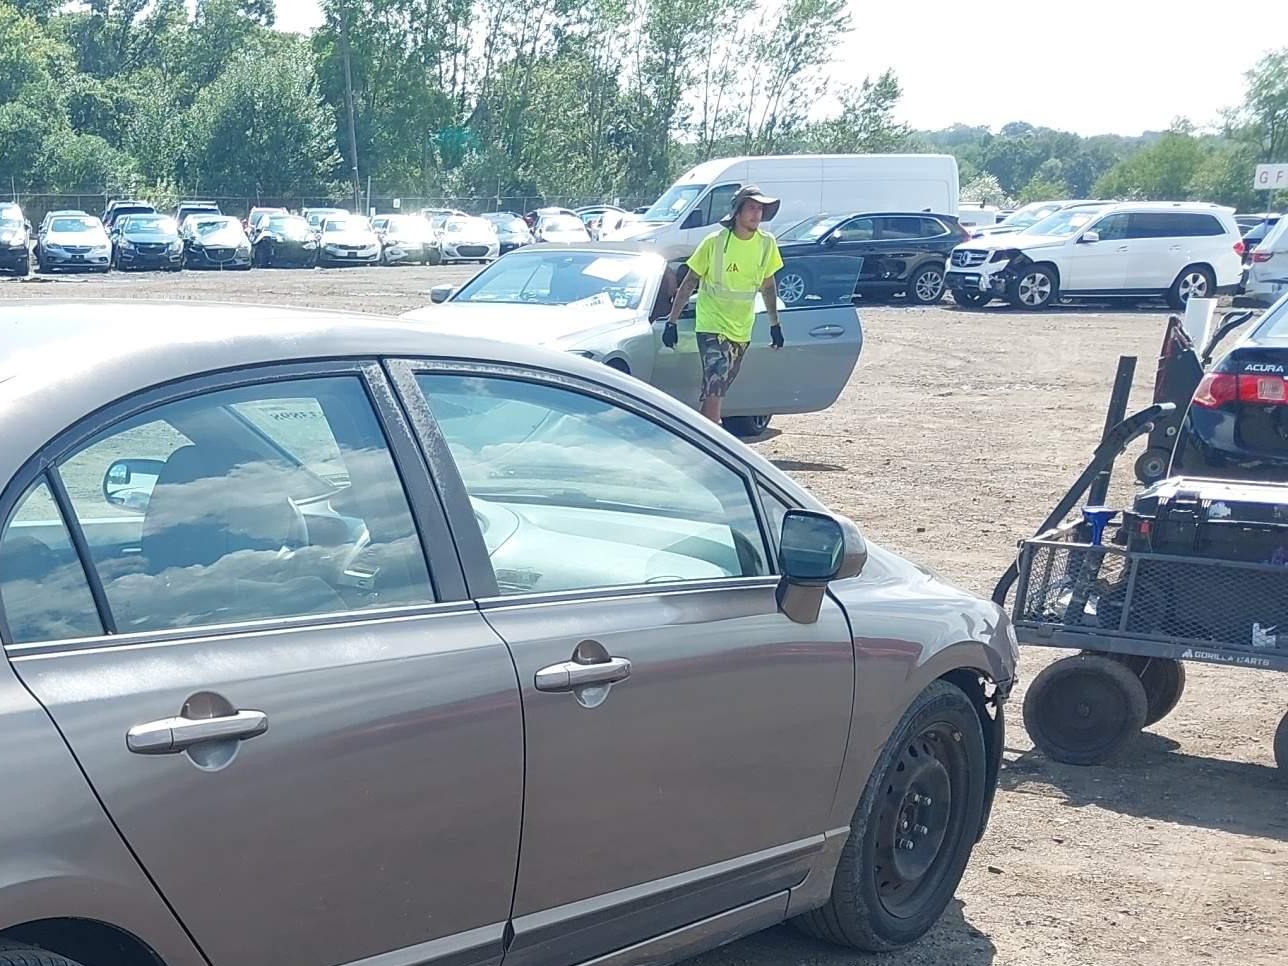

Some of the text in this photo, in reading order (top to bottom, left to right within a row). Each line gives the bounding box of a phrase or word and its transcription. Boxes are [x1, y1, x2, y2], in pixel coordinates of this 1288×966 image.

[1259, 170, 1269, 184] G
[1244, 363, 1284, 373] ACURA
[1194, 651, 1234, 663] GORILLA
